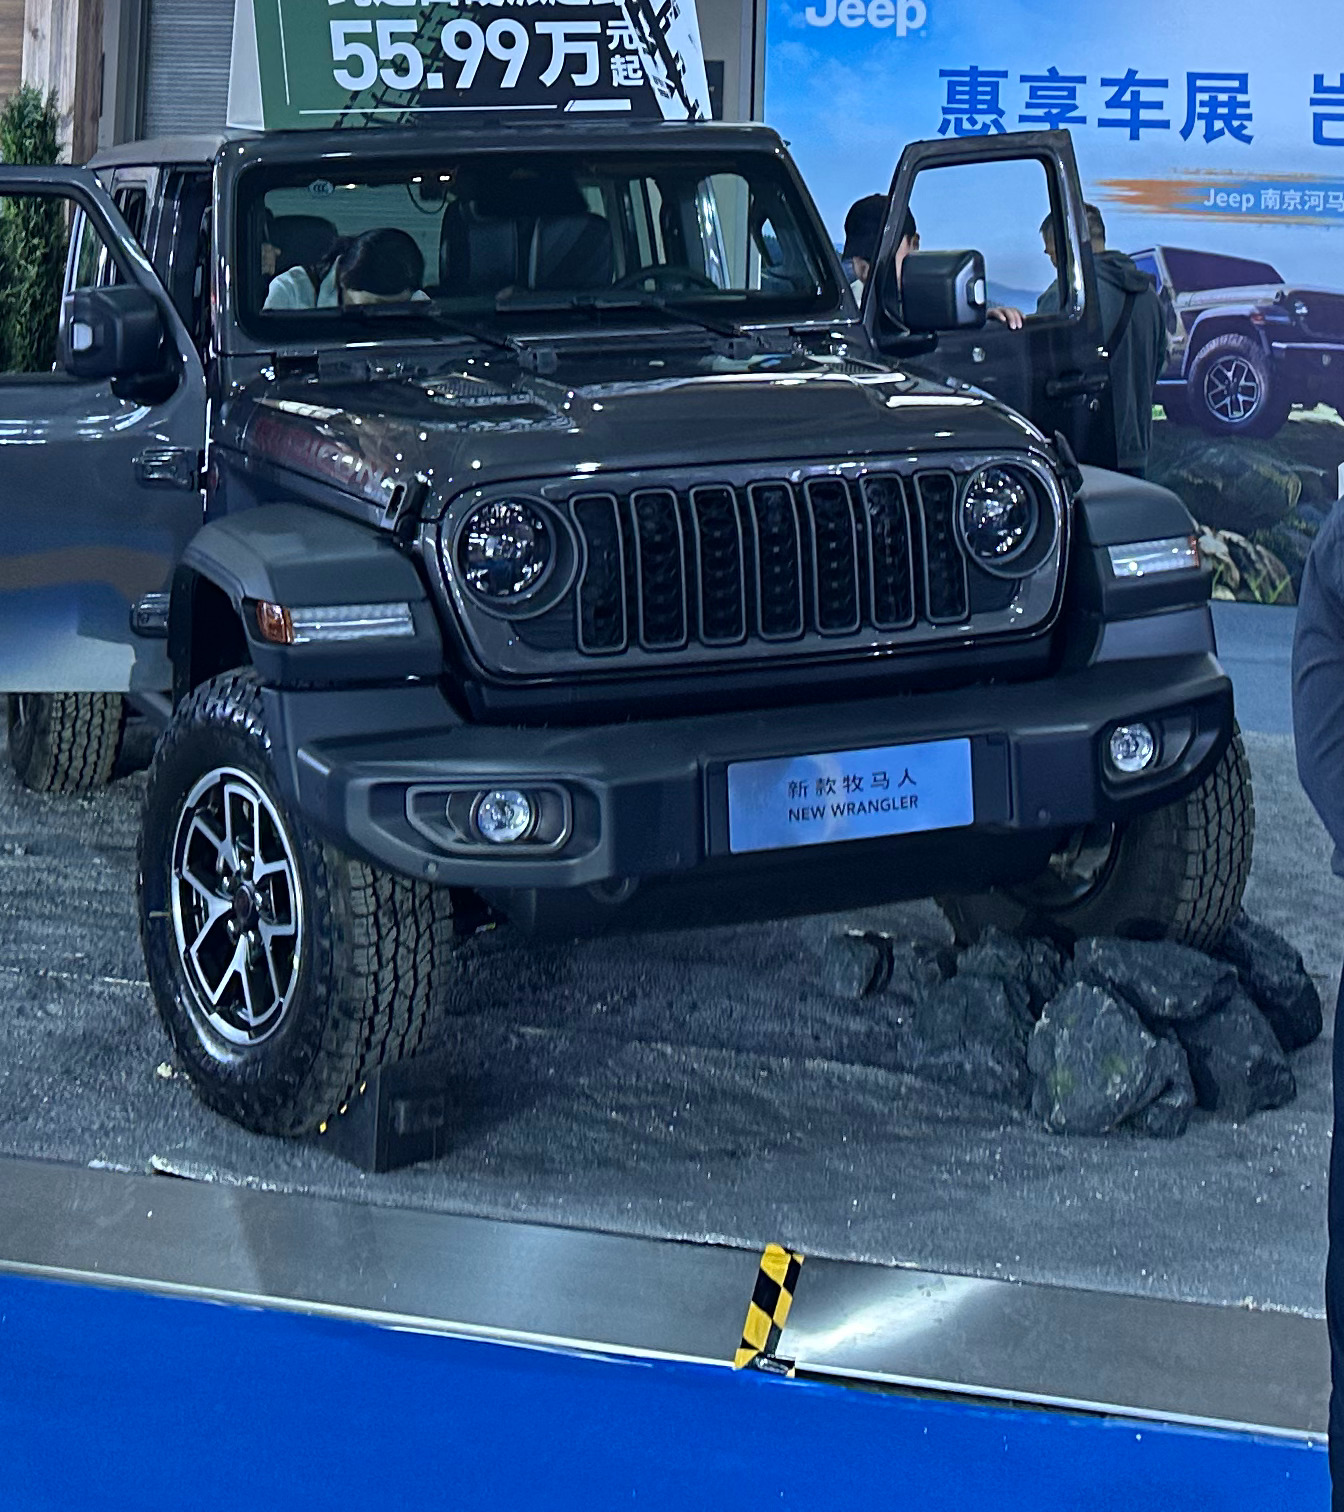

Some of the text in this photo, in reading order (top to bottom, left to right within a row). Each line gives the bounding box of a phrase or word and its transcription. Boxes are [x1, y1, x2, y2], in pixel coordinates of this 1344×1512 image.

[328, 18, 602, 91] 55.99万
[937, 65, 1255, 145] 惠享车展
[1203, 188, 1255, 211] Jeep
[788, 767, 917, 800] 新款牧马人
[788, 794, 919, 822] NEW WRANGLER
